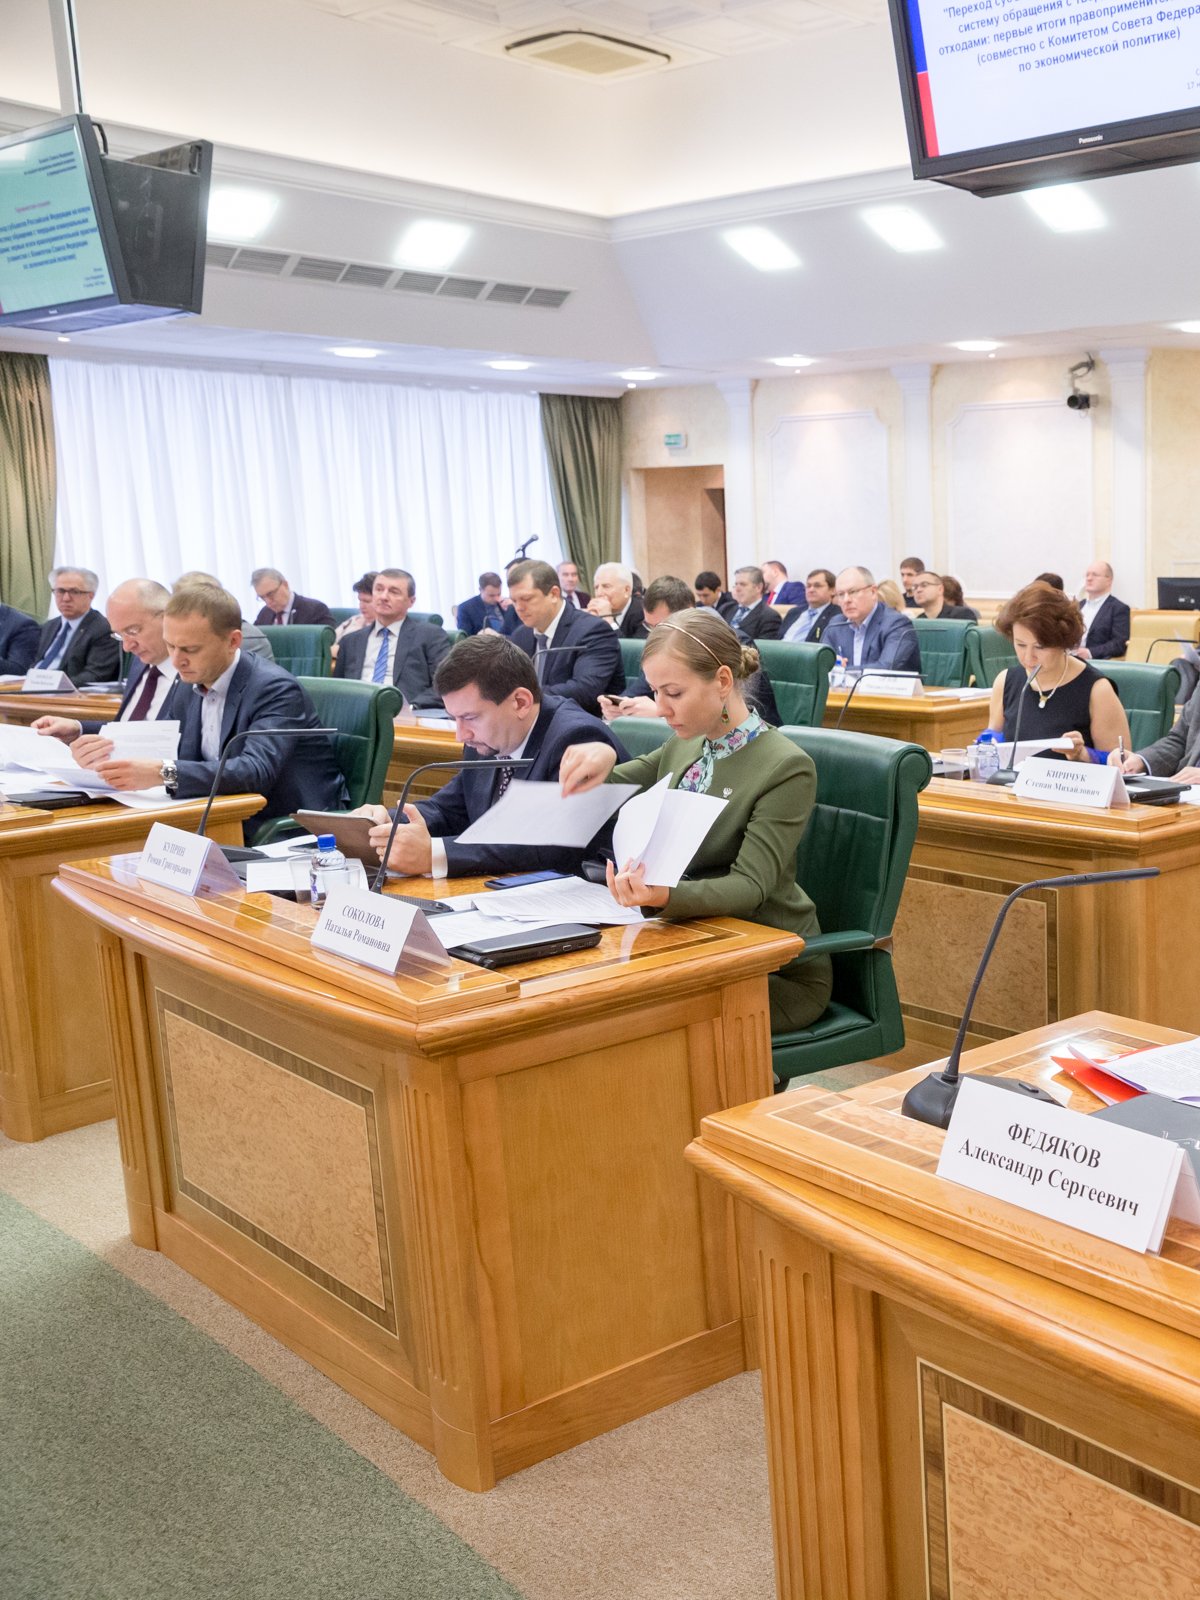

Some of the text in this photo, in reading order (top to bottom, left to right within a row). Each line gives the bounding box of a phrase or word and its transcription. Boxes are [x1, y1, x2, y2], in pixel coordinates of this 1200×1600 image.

[958, 16, 1000, 33] систему
[1002, 1, 1063, 22] обращения
[939, 36, 991, 56] отходами:
[993, 25, 1033, 42] первые
[1036, 17, 1067, 32] итоги
[977, 42, 1036, 66] (совместно
[1039, 40, 1045, 49] с
[1047, 25, 1109, 48] Комитетом
[1111, 15, 1153, 33] Совета
[1019, 26, 1181, 72] по экономической политике)
[1186, 81, 1195, 90] 17
[1025, 779, 1101, 796] Степан Михайлович
[1046, 769, 1088, 782] КИРИЧУК
[342, 905, 386, 930] СОКОЛОВА
[325, 918, 353, 939] Наталья
[352, 928, 391, 953] Романовна
[1007, 1122, 1101, 1169] ФЕДЯКОВ
[958, 1138, 1140, 1217] Александр Сергеевич
